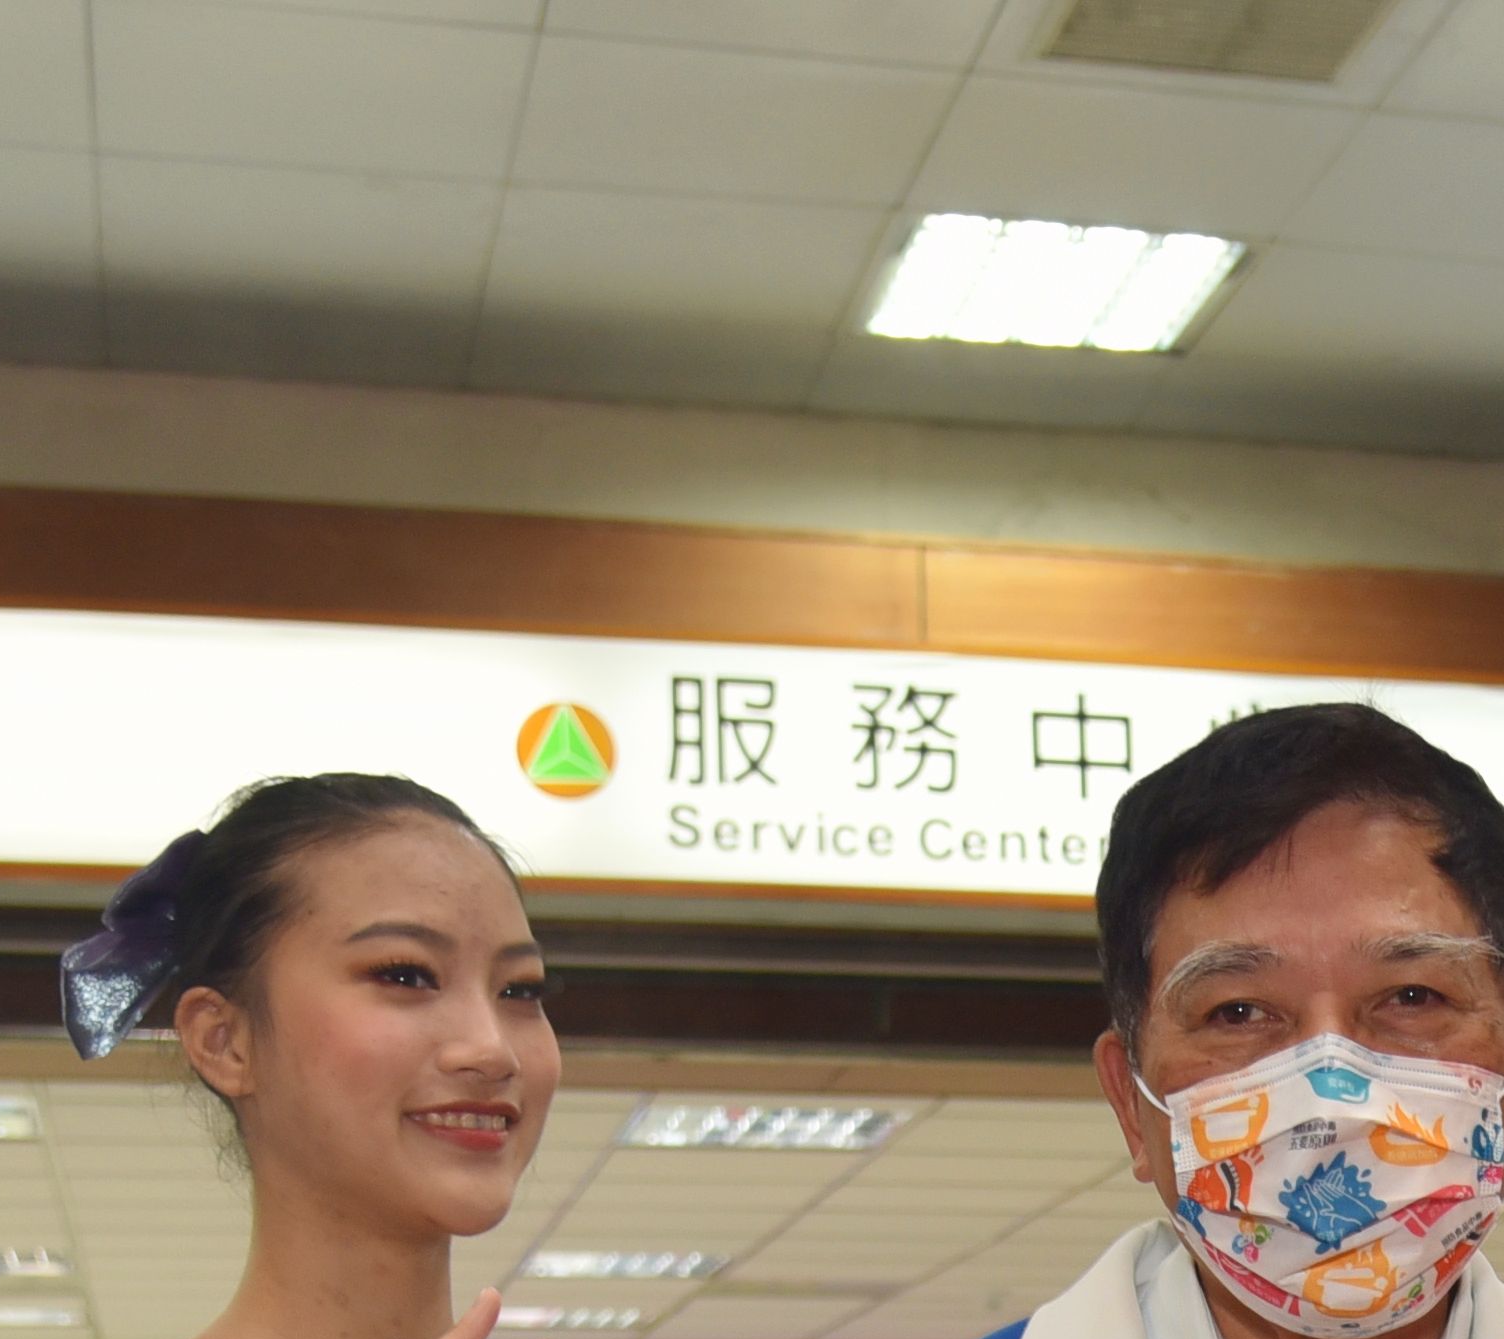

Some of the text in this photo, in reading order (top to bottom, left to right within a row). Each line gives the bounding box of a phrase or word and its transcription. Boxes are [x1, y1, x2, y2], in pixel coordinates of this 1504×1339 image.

[666, 674, 1236, 801] 服務中
[667, 804, 894, 859] Service
